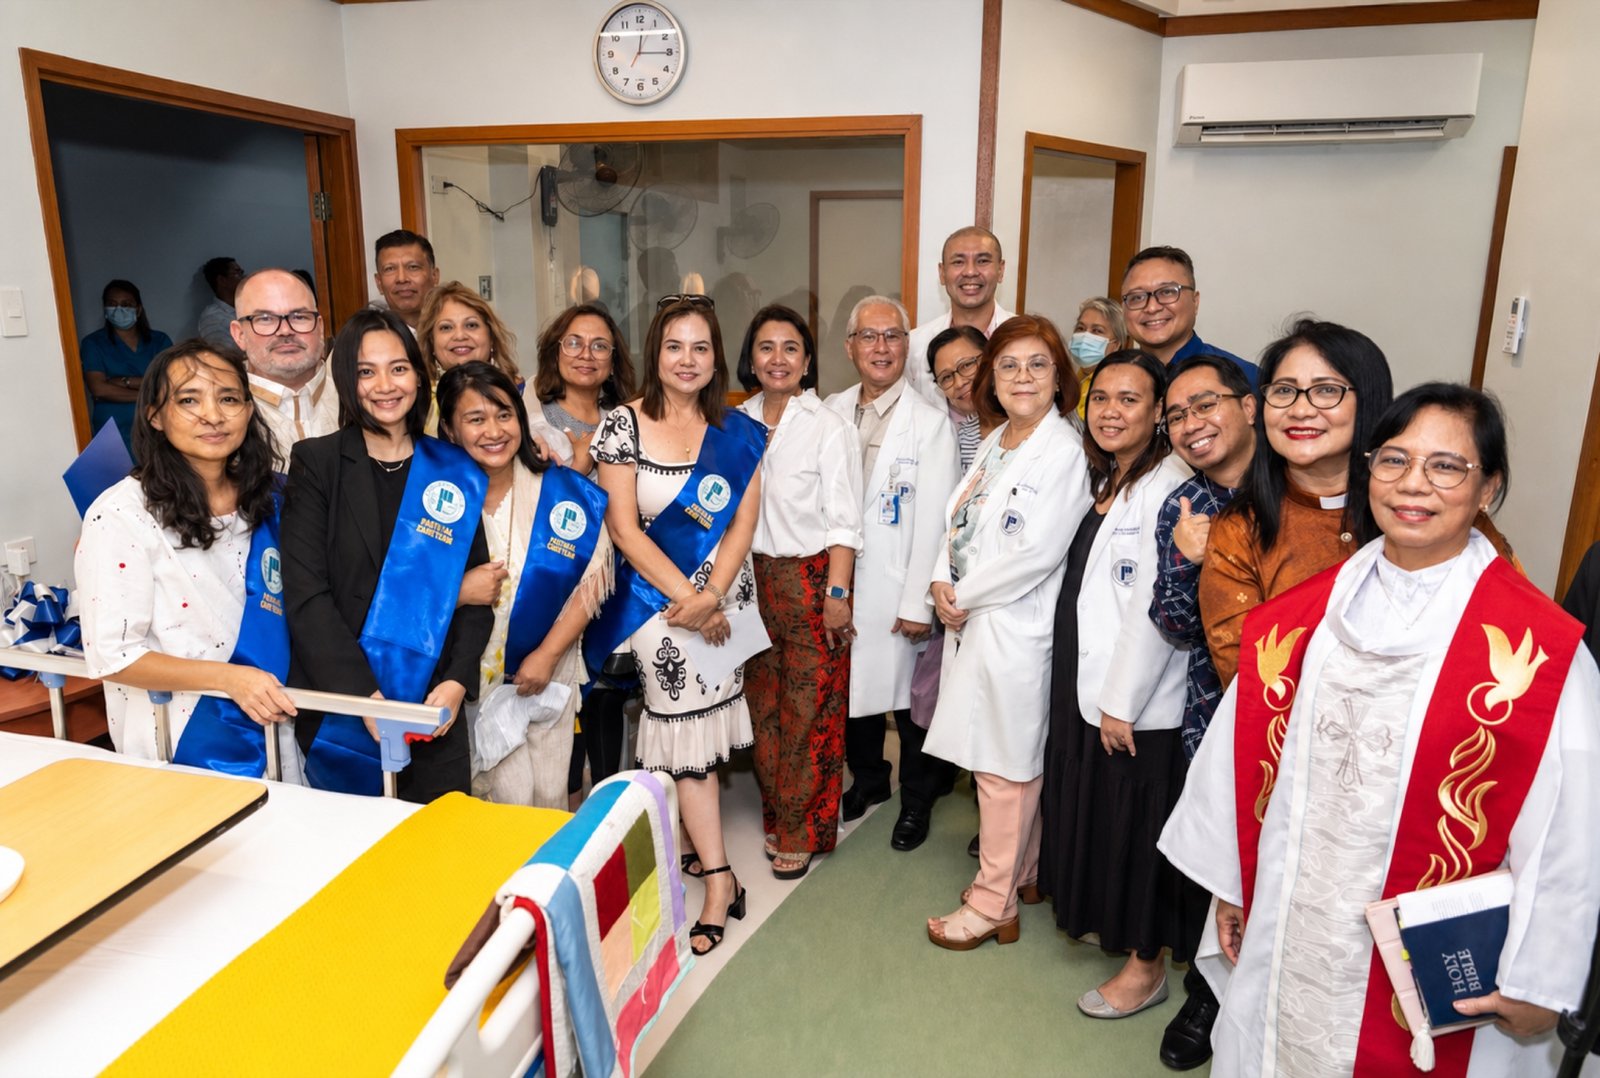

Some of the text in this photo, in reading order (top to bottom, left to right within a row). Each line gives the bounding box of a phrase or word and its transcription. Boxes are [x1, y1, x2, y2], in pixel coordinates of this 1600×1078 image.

[636, 15, 645, 24] 12
[653, 19, 657, 28] 1
[621, 21, 629, 29] 11
[662, 33, 669, 41] 2
[607, 50, 614, 58] 9
[666, 48, 673, 56] 3
[612, 67, 619, 75] 8
[663, 65, 669, 73] 4
[623, 77, 630, 86] 7
[652, 77, 659, 86] 5
[637, 82, 644, 91] 6
[1442, 953, 1467, 995] HOLY
[1457, 948, 1482, 993] BIBLE
